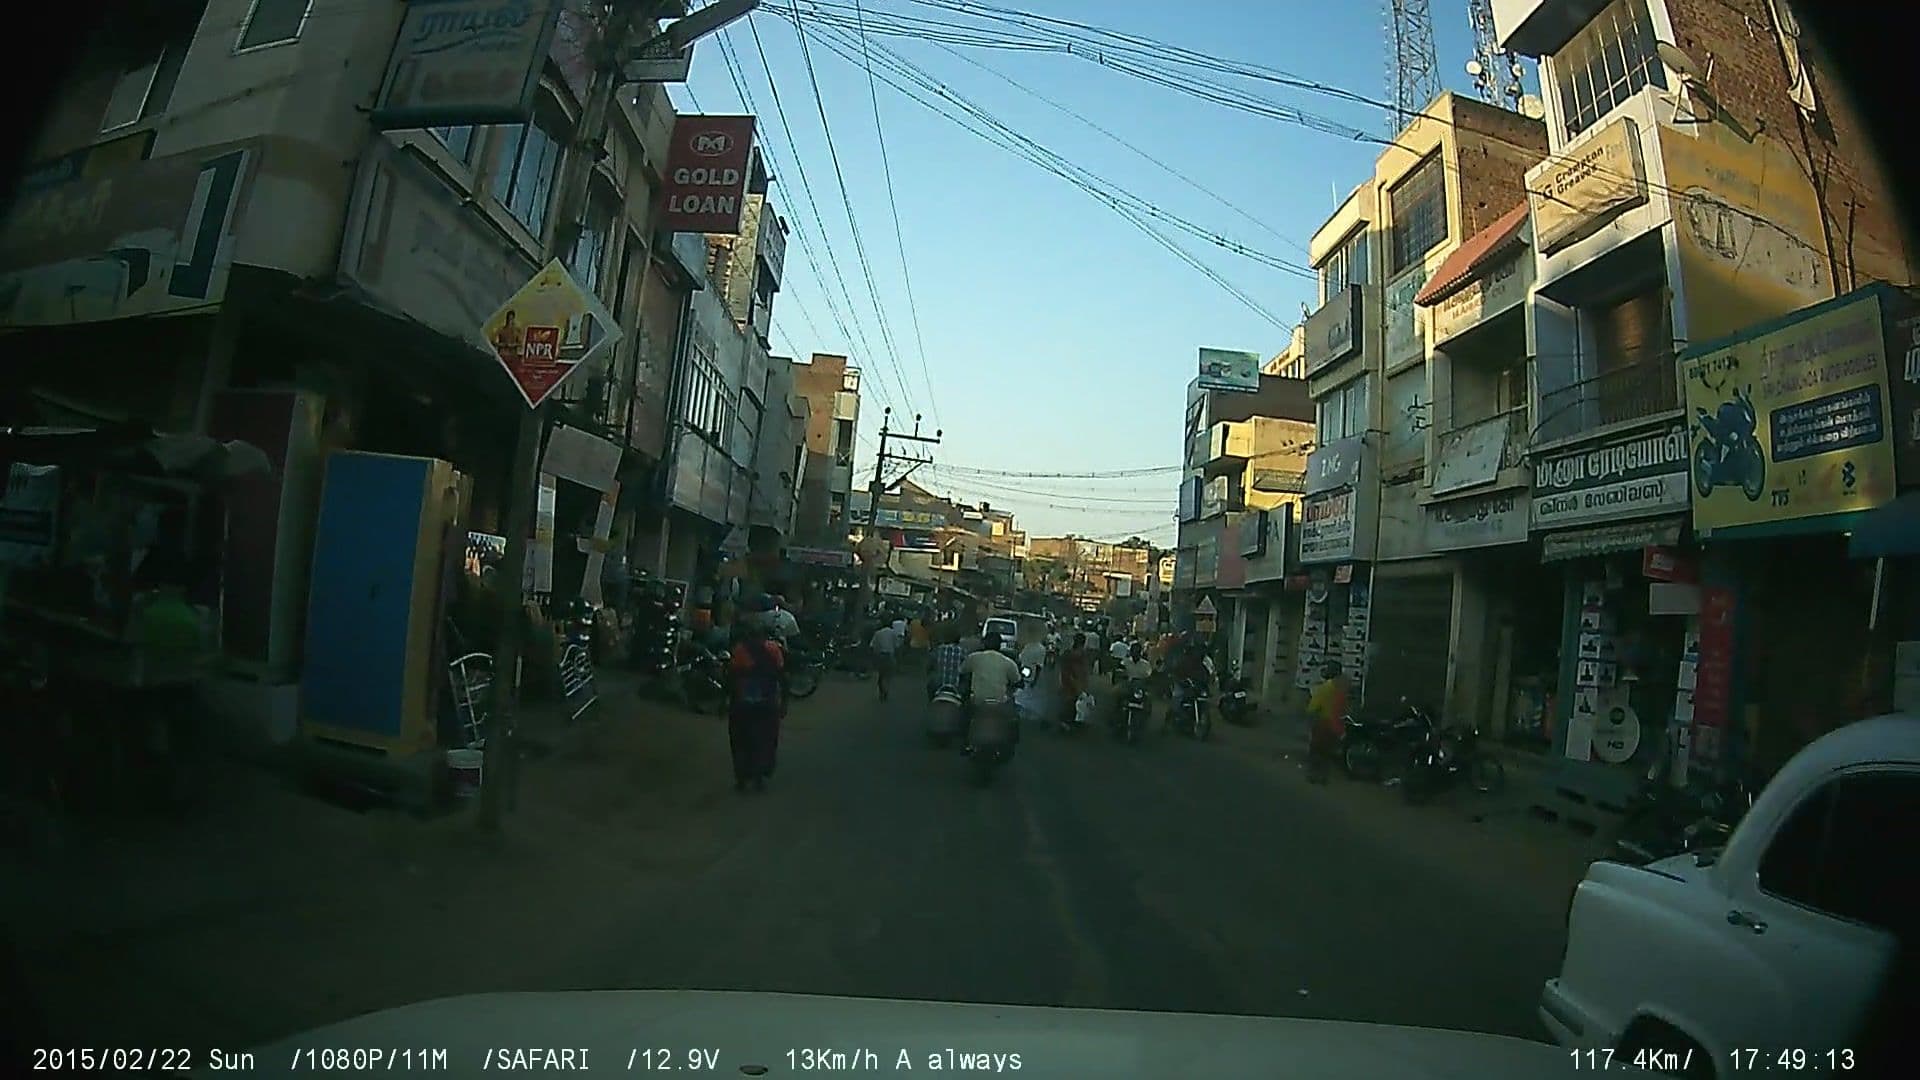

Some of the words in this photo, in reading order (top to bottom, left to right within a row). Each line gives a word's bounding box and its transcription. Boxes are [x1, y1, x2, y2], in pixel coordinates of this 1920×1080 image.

[1554, 145, 1604, 184] Crompton
[674, 167, 740, 185] GOLD
[668, 194, 735, 214] LOAN
[525, 342, 553, 361] NPR
[1771, 488, 1790, 508] TVS
